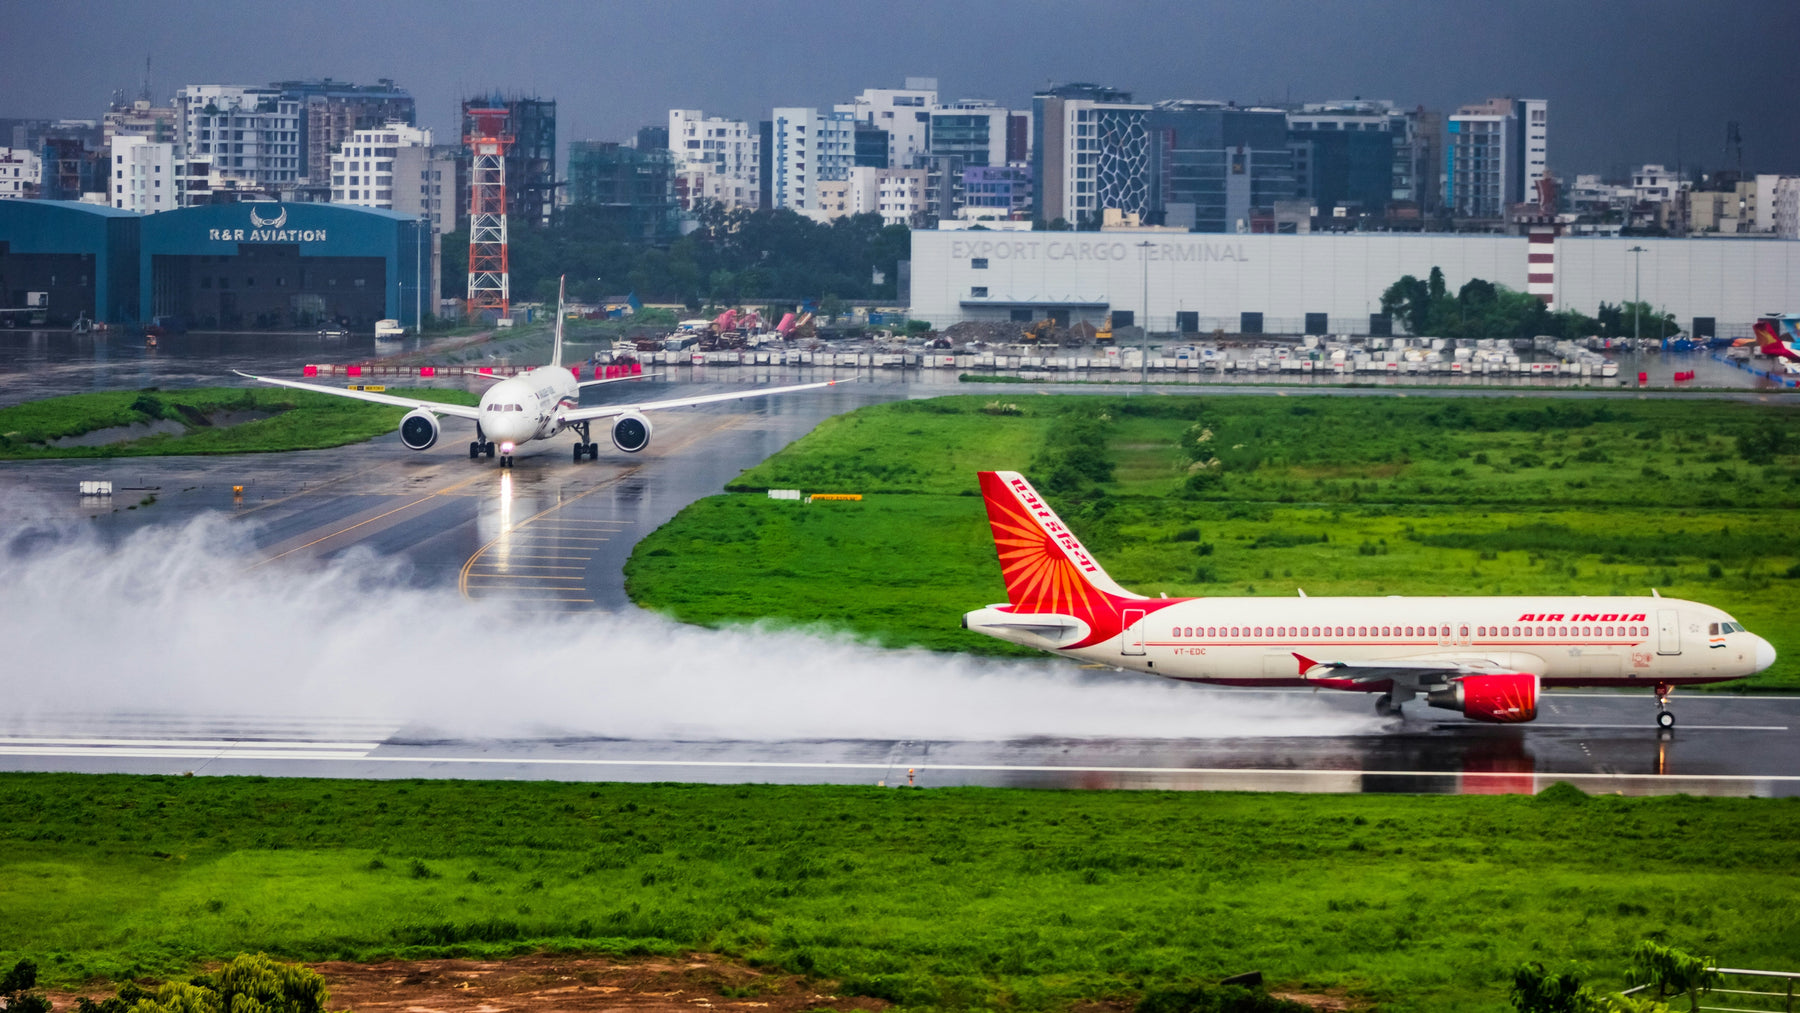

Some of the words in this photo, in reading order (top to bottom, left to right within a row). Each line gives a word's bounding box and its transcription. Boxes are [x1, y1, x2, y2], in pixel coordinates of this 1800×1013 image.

[209, 228, 245, 241] R&R
[249, 229, 327, 242] AVIATION
[951, 240, 1040, 261] EXPORT
[1046, 241, 1127, 261] CARGO
[1136, 243, 1249, 262] TERMINAL
[1517, 613, 1565, 622] AIR
[1570, 613, 1647, 622] INDIA
[1173, 648, 1206, 656] VT-EDC
